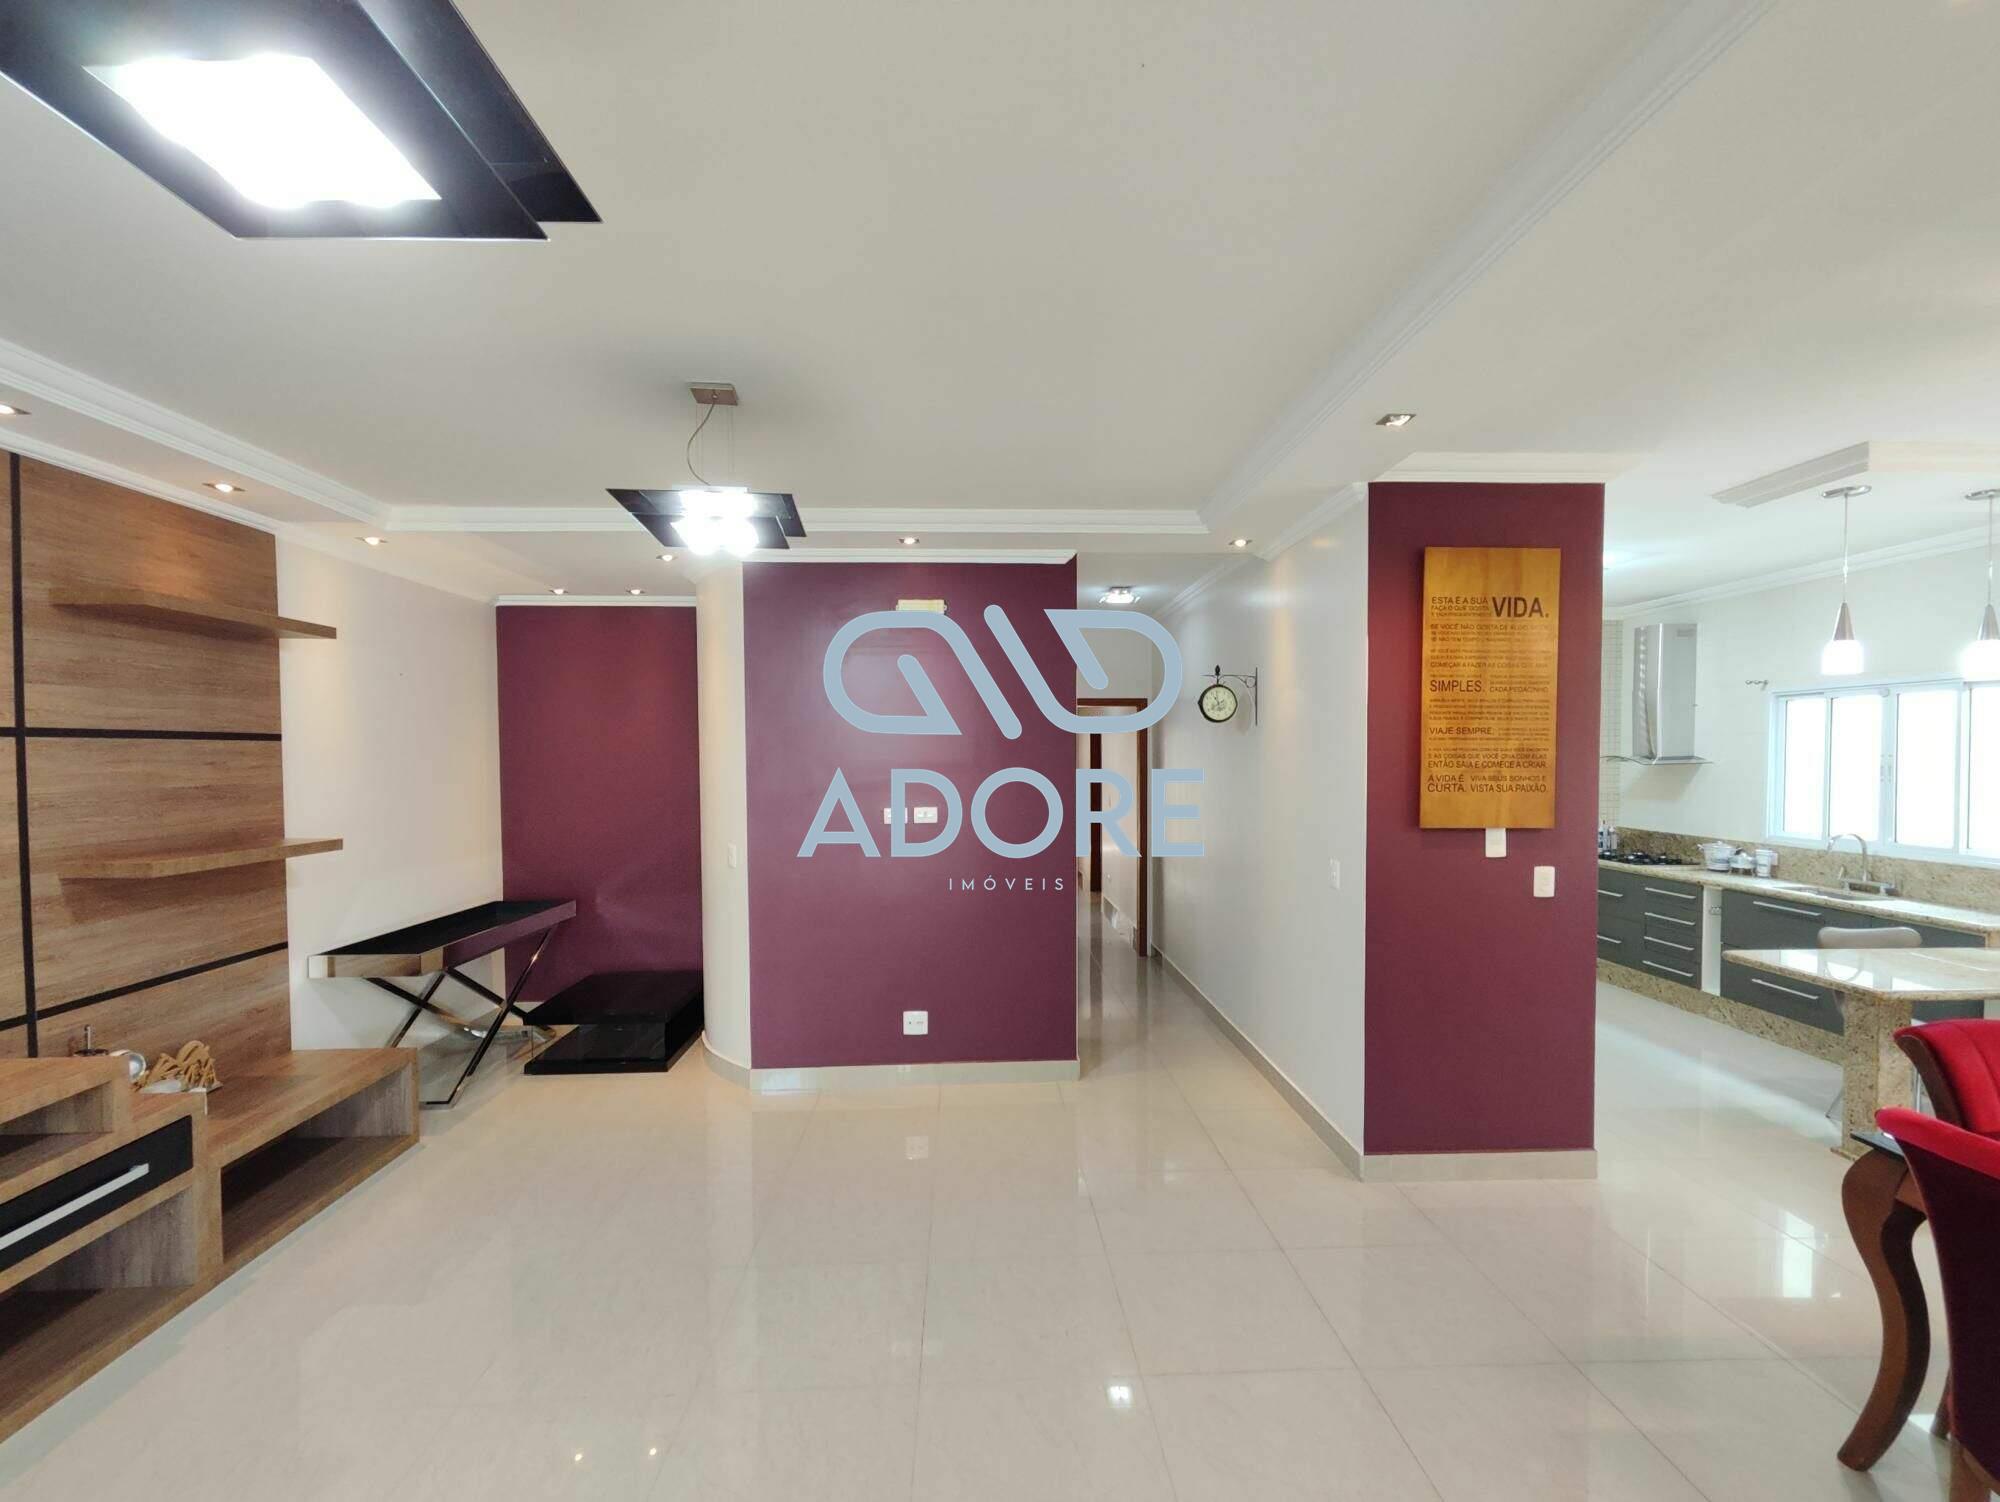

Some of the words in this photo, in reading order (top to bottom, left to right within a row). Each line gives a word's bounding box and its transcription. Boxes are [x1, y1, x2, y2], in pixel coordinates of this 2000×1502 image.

[1431, 596, 1454, 605] ESTA
[1462, 596, 1469, 605] A
[1470, 596, 1489, 605] SUA
[1491, 596, 1550, 618] VIDA.
[1429, 679, 1486, 693] SIMPLES.
[1429, 726, 1454, 735] VIAJE
[1428, 760, 1454, 769] ENTÃO
[1427, 774, 1434, 783] A
[1435, 774, 1457, 783] VIDA
[1458, 773, 1465, 783] É
[1427, 783, 1467, 793] CURTA.
[1470, 783, 1495, 793] VISTA
[1495, 783, 1514, 793] SUA
